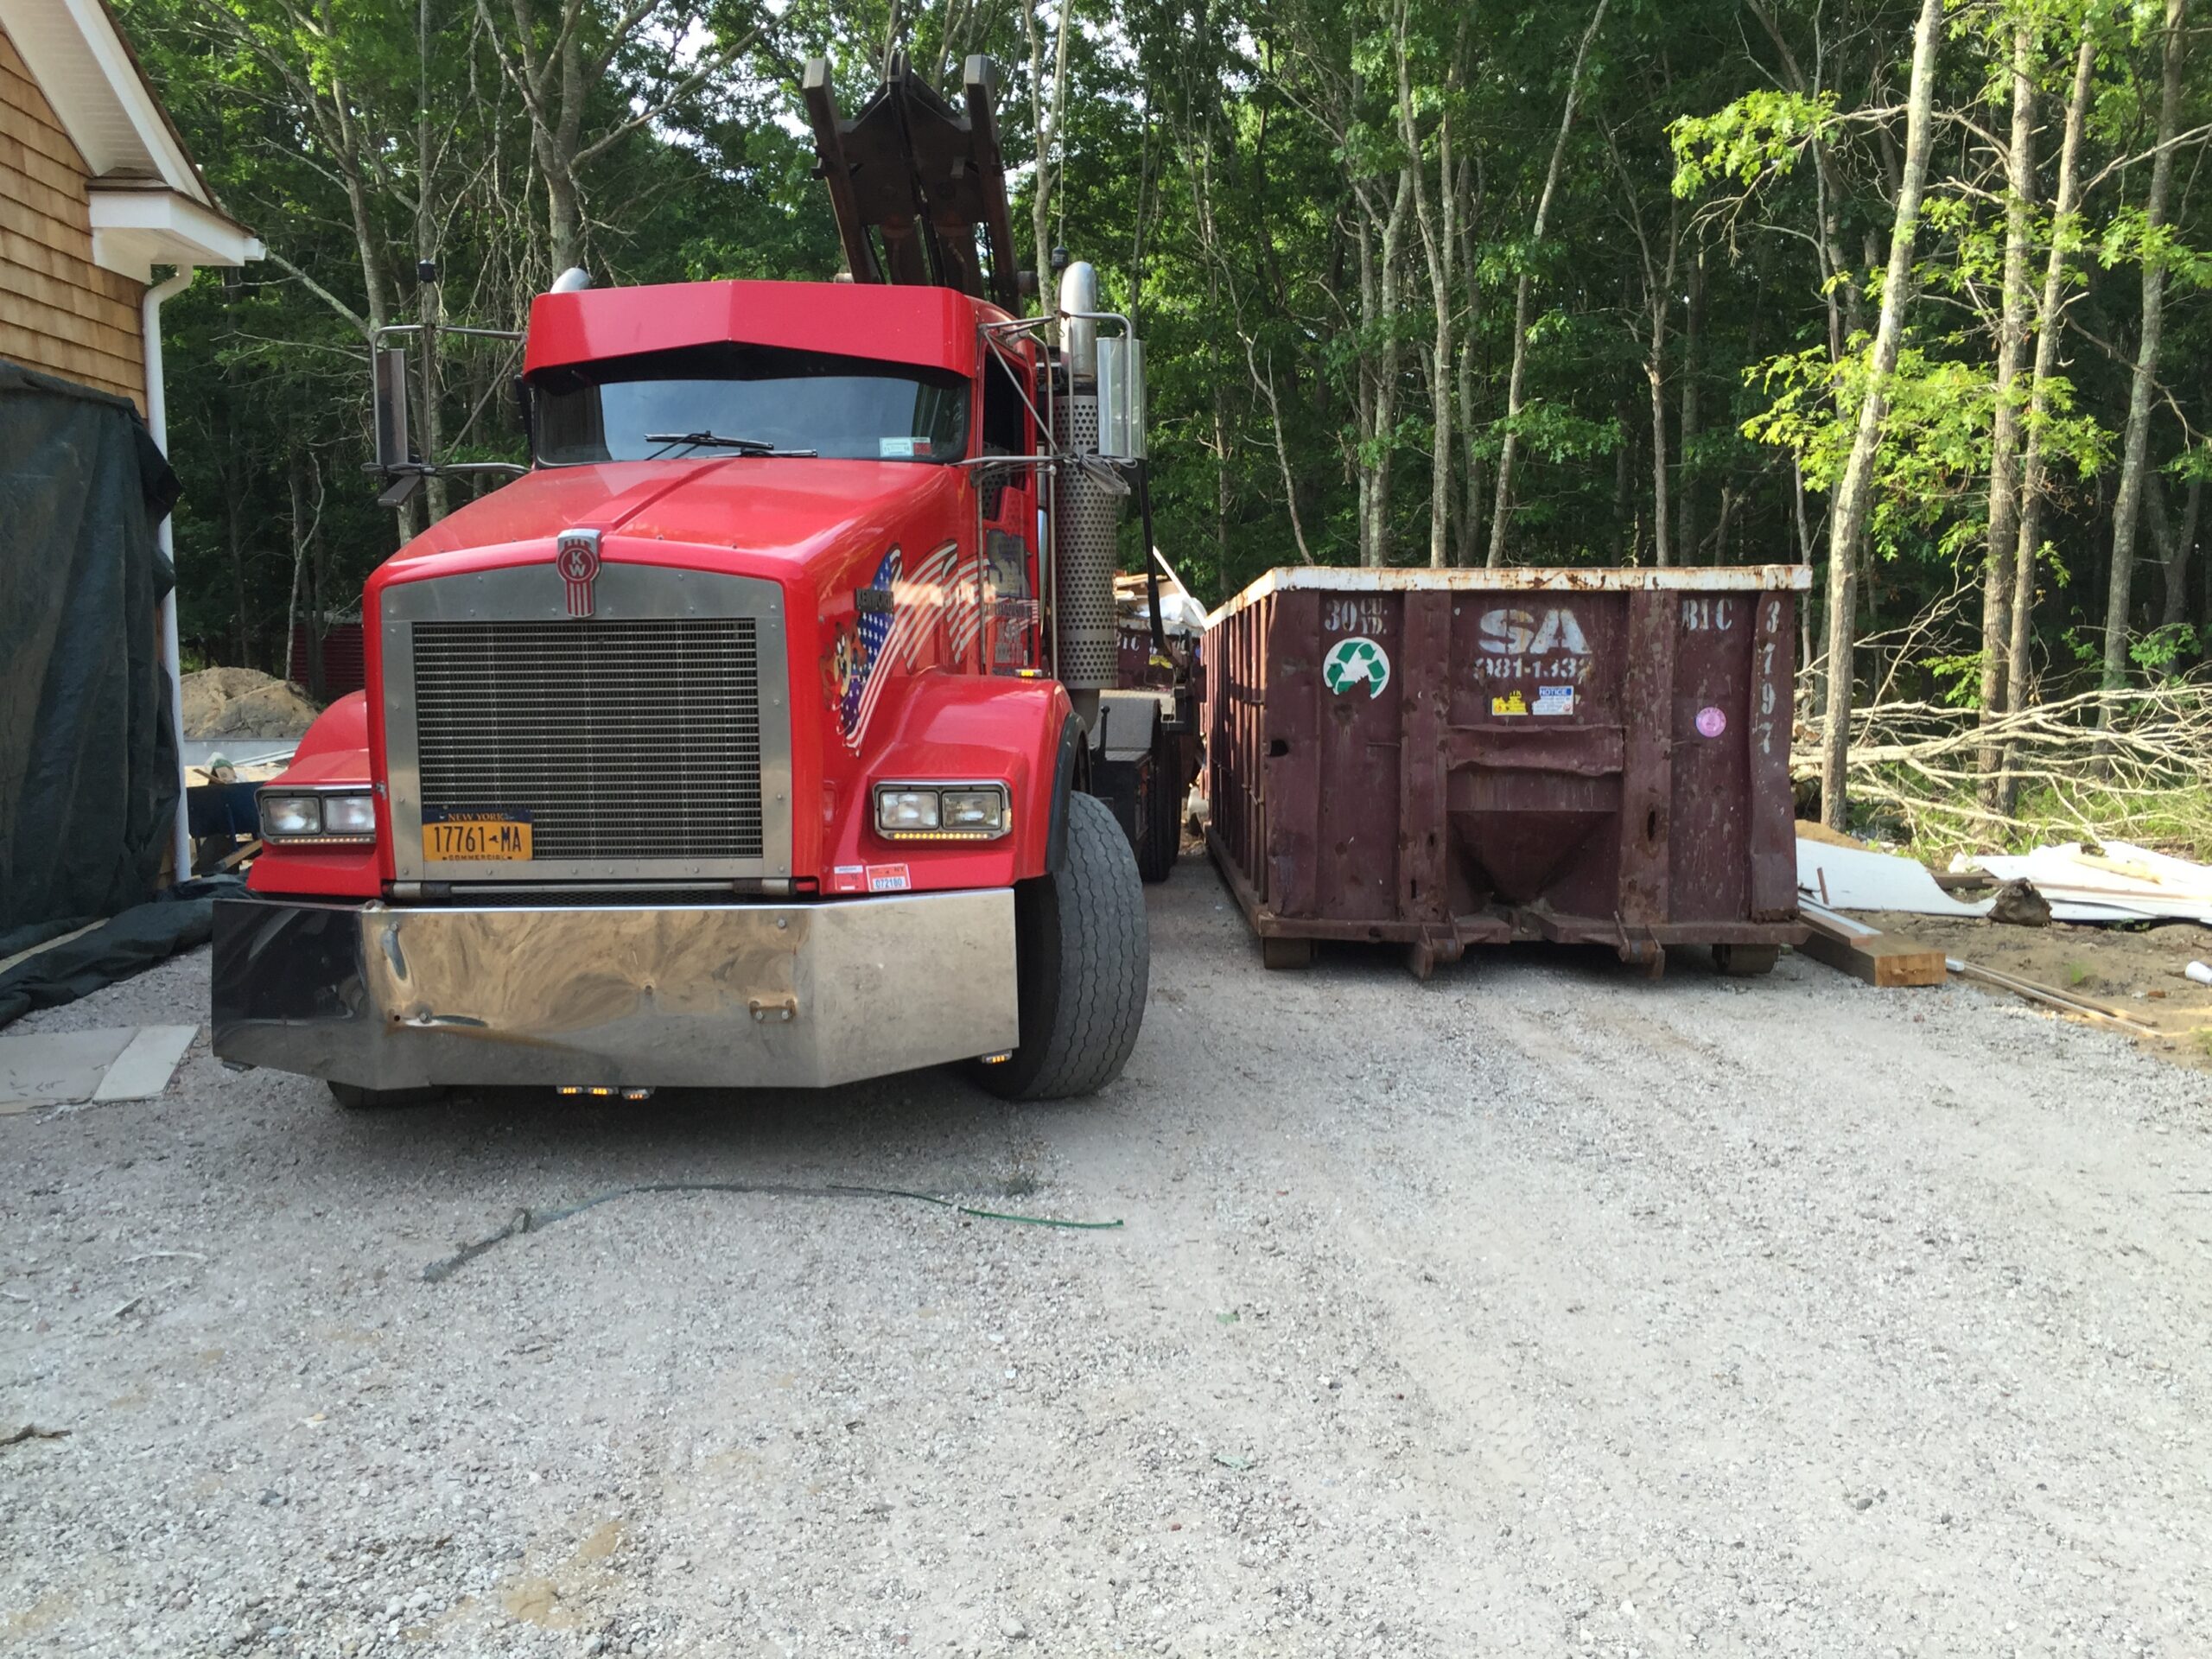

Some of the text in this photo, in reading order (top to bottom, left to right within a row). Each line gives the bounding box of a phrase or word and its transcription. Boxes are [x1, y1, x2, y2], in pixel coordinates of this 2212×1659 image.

[1324, 600, 1357, 632] 30
[1478, 608, 1592, 655] SA
[448, 813, 504, 822] NEW YORK
[434, 825, 522, 852] 17761 MA
